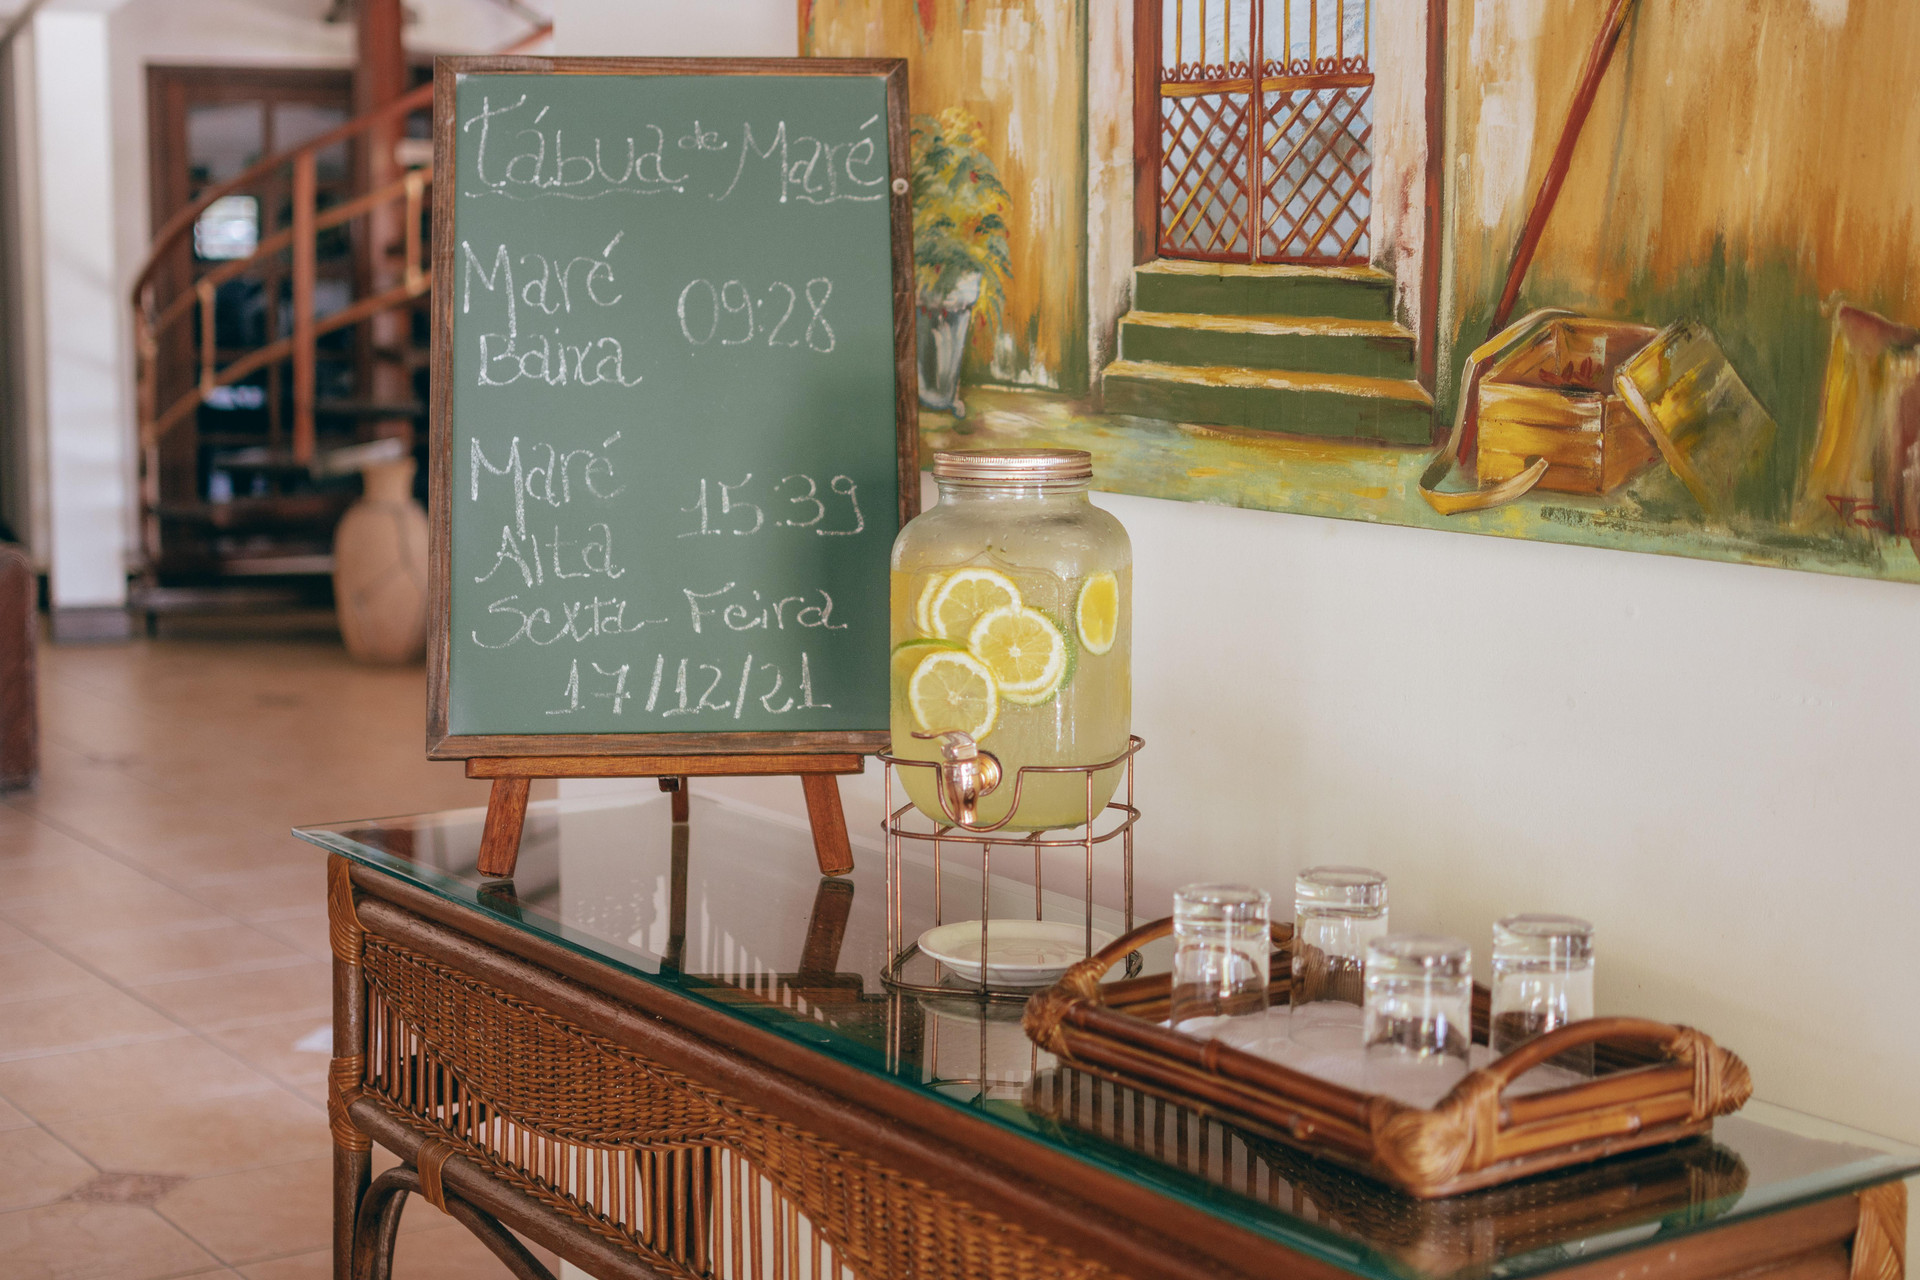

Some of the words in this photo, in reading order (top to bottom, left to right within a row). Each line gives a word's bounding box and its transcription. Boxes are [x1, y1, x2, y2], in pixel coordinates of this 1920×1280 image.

[463, 93, 689, 188] Tábua
[678, 120, 728, 150] de
[707, 113, 885, 203] Maré
[462, 230, 624, 338] Maré
[677, 276, 837, 354] 09:28
[477, 327, 643, 388] Baixa
[470, 430, 627, 540] Maré
[676, 472, 866, 537] 15:39
[473, 522, 625, 588] Alta
[682, 581, 848, 634] Feira
[544, 652, 832, 719] 17/12/21
